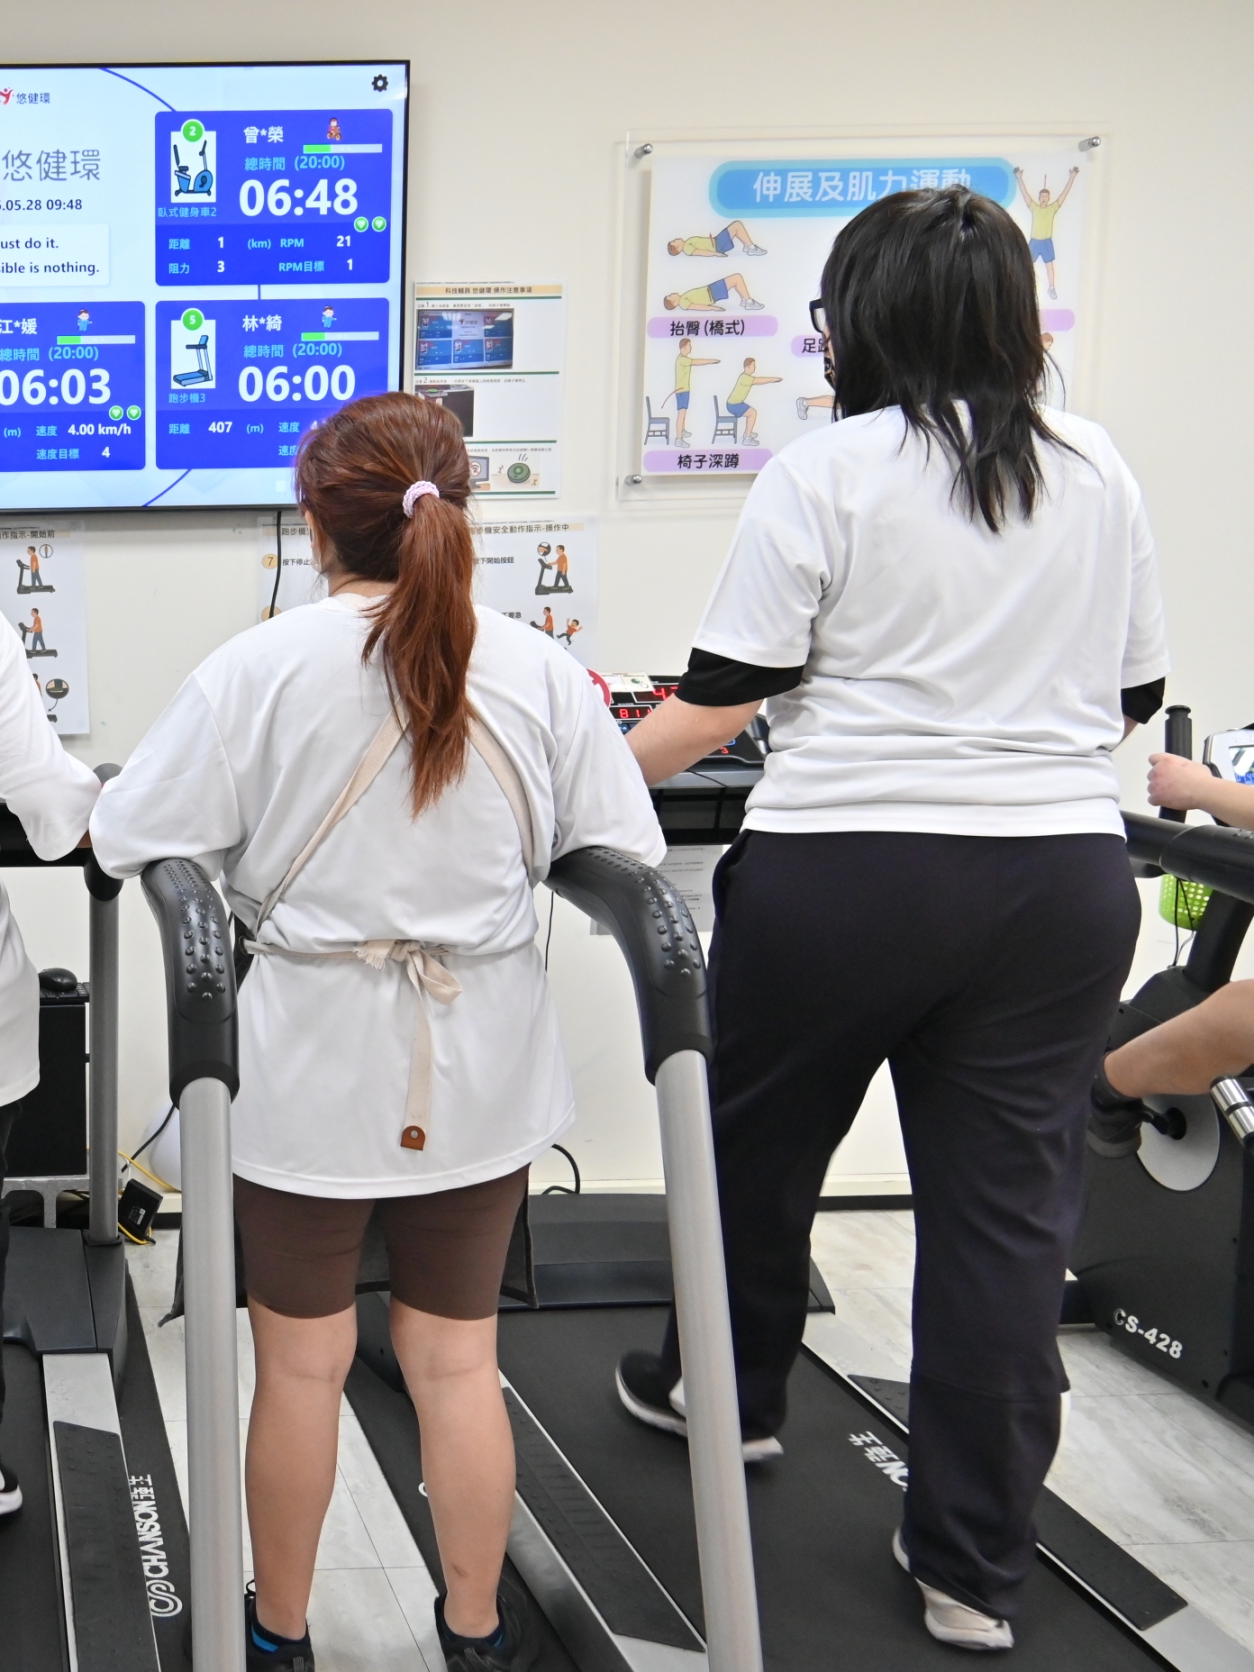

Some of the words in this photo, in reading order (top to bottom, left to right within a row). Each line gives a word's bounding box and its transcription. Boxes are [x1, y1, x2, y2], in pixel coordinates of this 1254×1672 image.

[16, 92, 50, 104] 悠健環
[189, 127, 196, 136] 2
[2, 149, 101, 181] 悠健環
[245, 157, 285, 171] 總時間
[294, 155, 345, 171] (20:00)
[46, 199, 82, 210] 09:48
[239, 178, 358, 217] 06:48
[158, 207, 217, 218] 臥式健身車2
[25, 238, 42, 249] do
[46, 238, 59, 249] it.
[168, 239, 190, 250] 距離
[218, 237, 224, 248] 1
[248, 238, 271, 249] (km)
[280, 239, 304, 248] RPM
[337, 235, 351, 247] 21
[29, 262, 40, 273] is
[44, 261, 99, 276] nothing.
[168, 263, 190, 274] 阻力
[217, 260, 225, 272] 3
[278, 261, 325, 272] RPM目標
[347, 259, 353, 270] 1
[190, 316, 196, 324] 5
[0, 348, 40, 362] 總時間
[48, 346, 99, 361] (20:00)
[244, 345, 284, 358] 總時間
[293, 343, 342, 358] (20:00)
[239, 365, 355, 401] 06:00
[168, 393, 206, 403] 跑步機3
[4, 427, 21, 437] (m)
[36, 426, 57, 436] 速度
[68, 424, 94, 435] 4.00
[99, 423, 131, 436] km/h
[169, 424, 190, 434] 距離
[209, 422, 232, 433] 407
[246, 424, 264, 434] (m)
[279, 422, 299, 433] 速度
[36, 449, 79, 460] 速度目標
[102, 447, 110, 457] 4
[678, 453, 739, 468] 椅子深蹲
[267, 556, 273, 566] 7
[283, 558, 310, 566] 按下停止
[1113, 1308, 1183, 1359] CS-428
[132, 1501, 169, 1578] CHANSON
